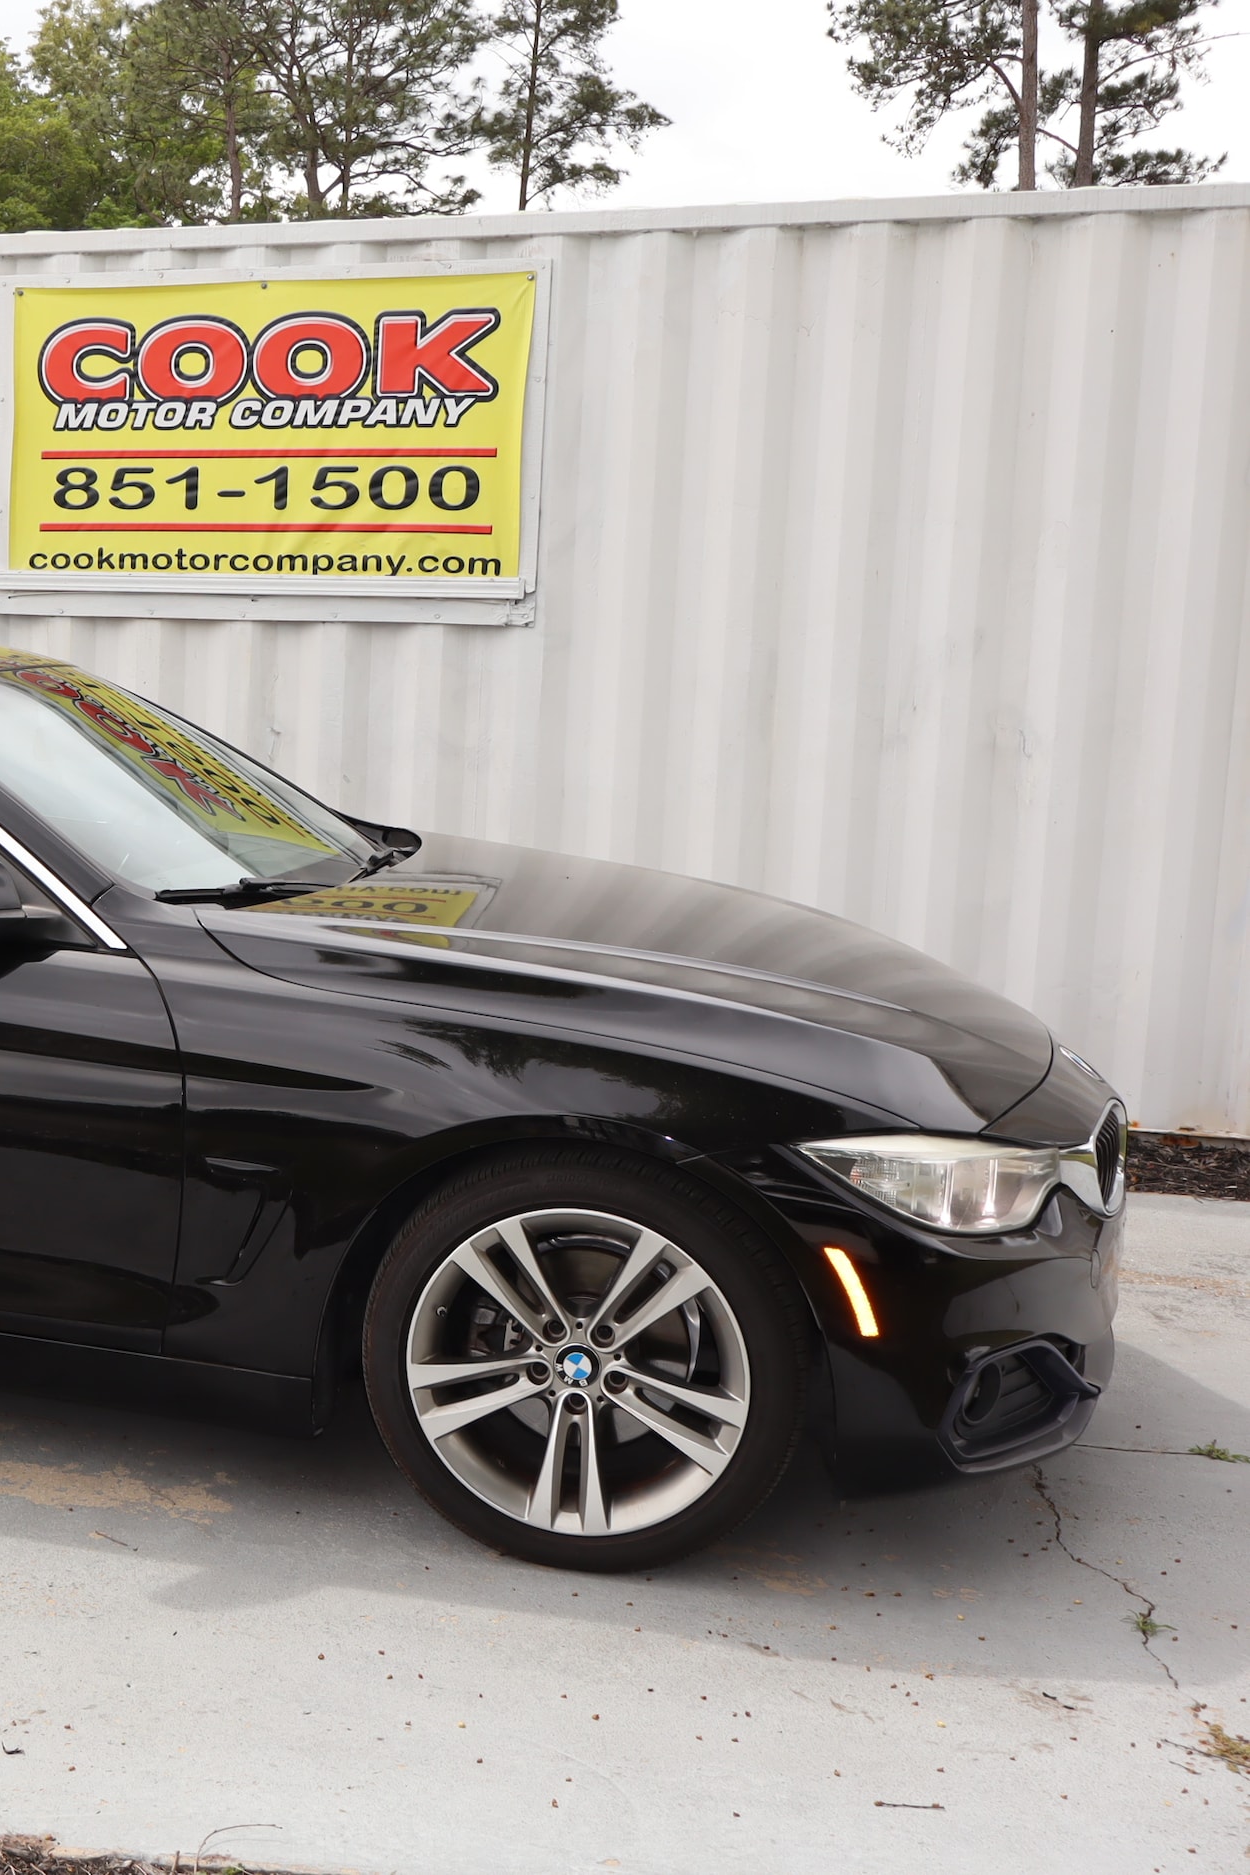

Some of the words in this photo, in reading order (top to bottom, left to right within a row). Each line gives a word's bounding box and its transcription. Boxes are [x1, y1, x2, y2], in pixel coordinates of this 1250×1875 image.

[38, 308, 500, 408] COOK
[53, 398, 219, 431] MOTOR
[230, 395, 477, 429] COMPANY
[53, 466, 480, 511] 851-1500
[28, 547, 502, 577] cookmotorcompany.com
